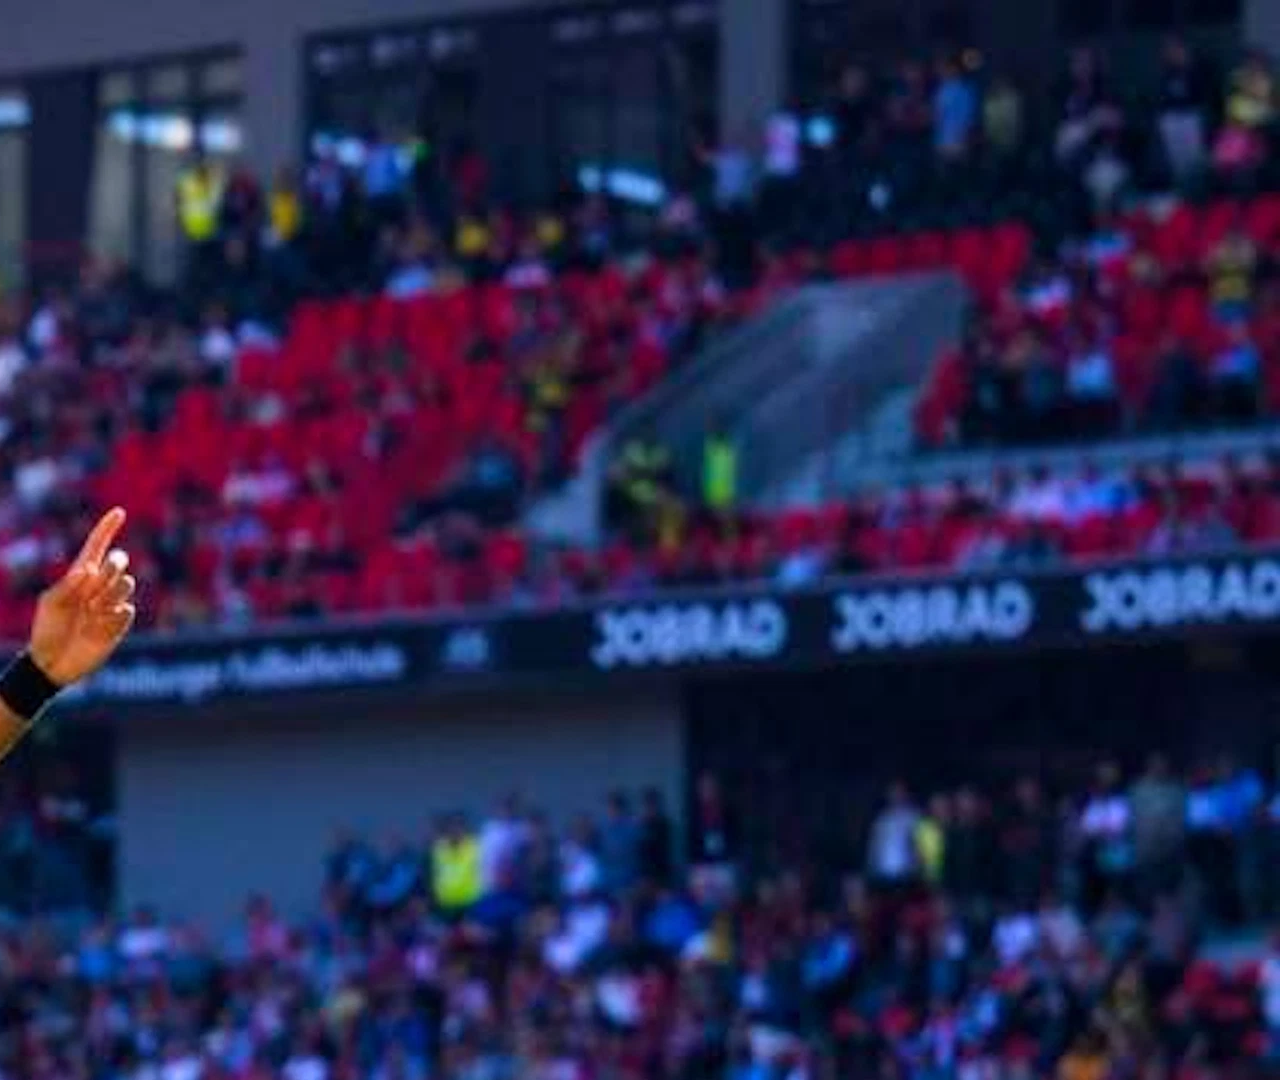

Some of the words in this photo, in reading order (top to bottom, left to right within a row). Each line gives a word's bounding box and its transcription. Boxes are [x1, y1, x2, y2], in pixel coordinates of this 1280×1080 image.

[832, 580, 1032, 652] JOBRAD
[1080, 559, 1280, 631] JOBRAD
[592, 602, 786, 668] JOBRAD
